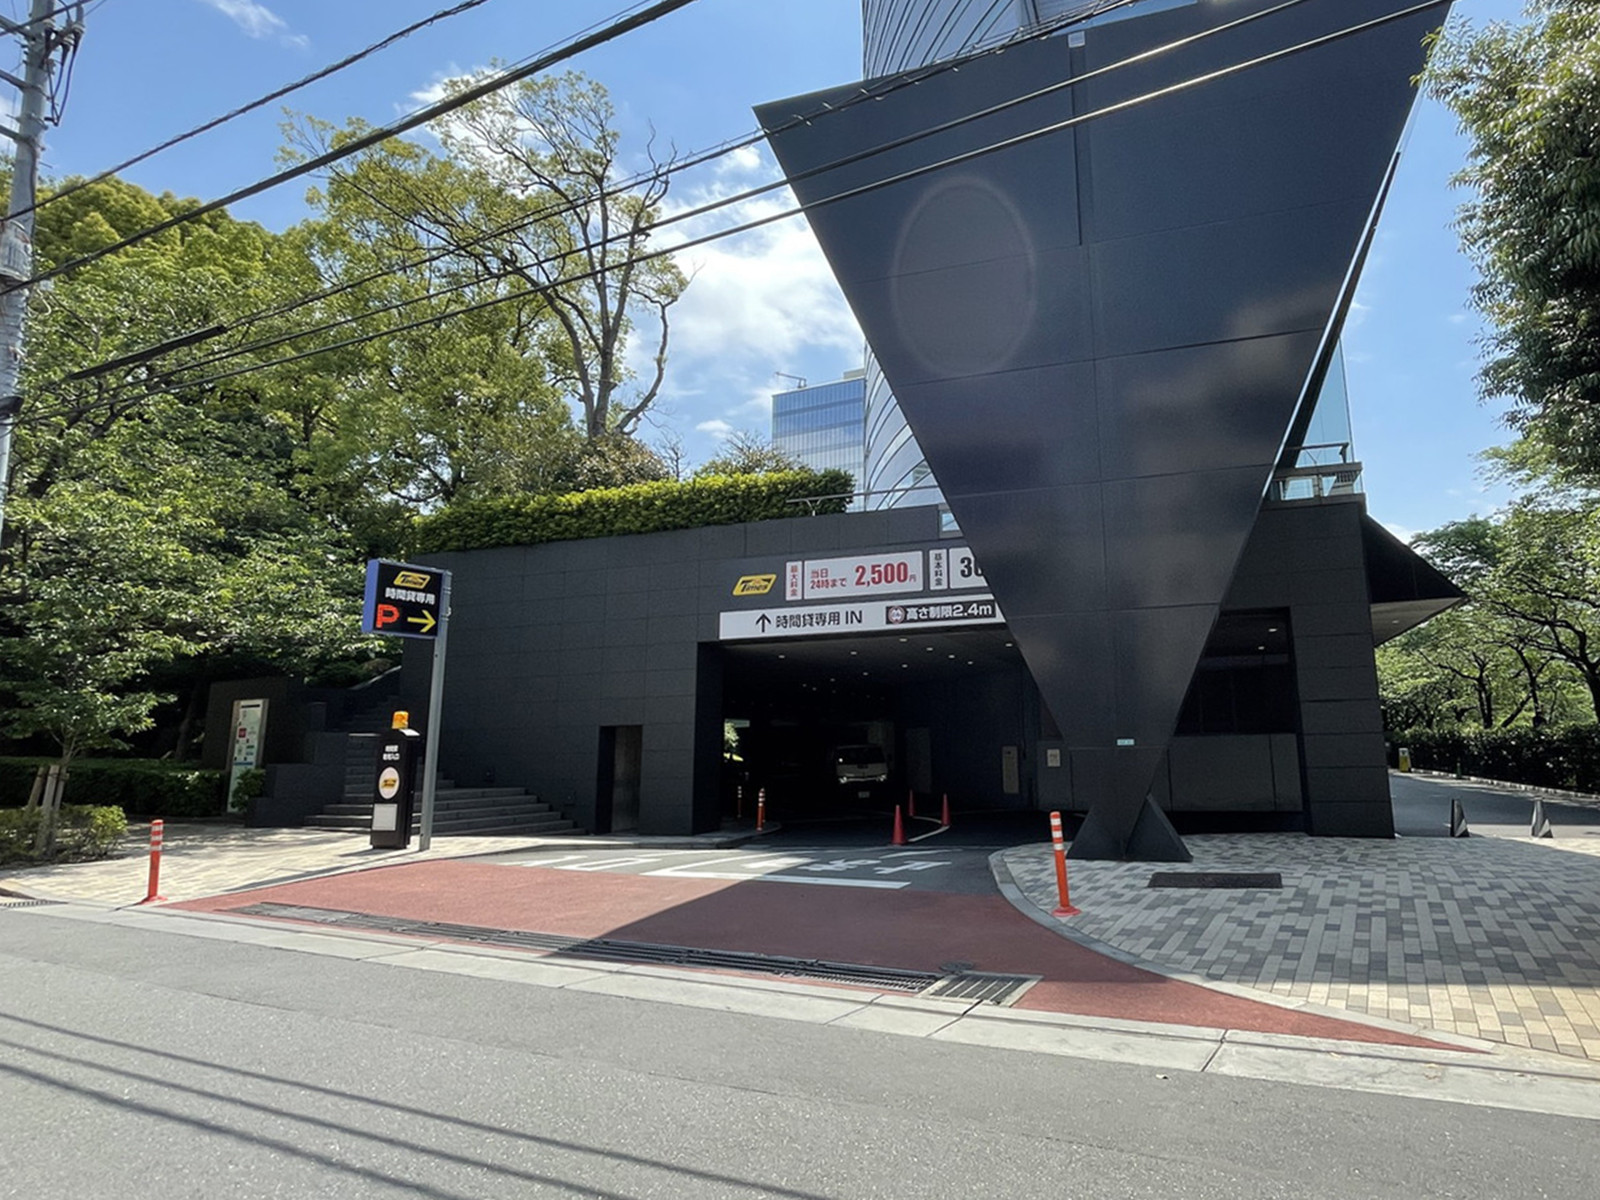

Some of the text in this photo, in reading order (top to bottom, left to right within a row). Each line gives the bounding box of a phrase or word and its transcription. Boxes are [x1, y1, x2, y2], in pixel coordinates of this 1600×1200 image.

[811, 568, 829, 579] 当日
[934, 553, 943, 586] 基本料金
[738, 576, 774, 594] Times
[790, 565, 798, 596] 最大料金
[810, 578, 847, 590] 24時まで
[376, 603, 400, 629] P
[776, 610, 863, 629] 時間貸専用 IN
